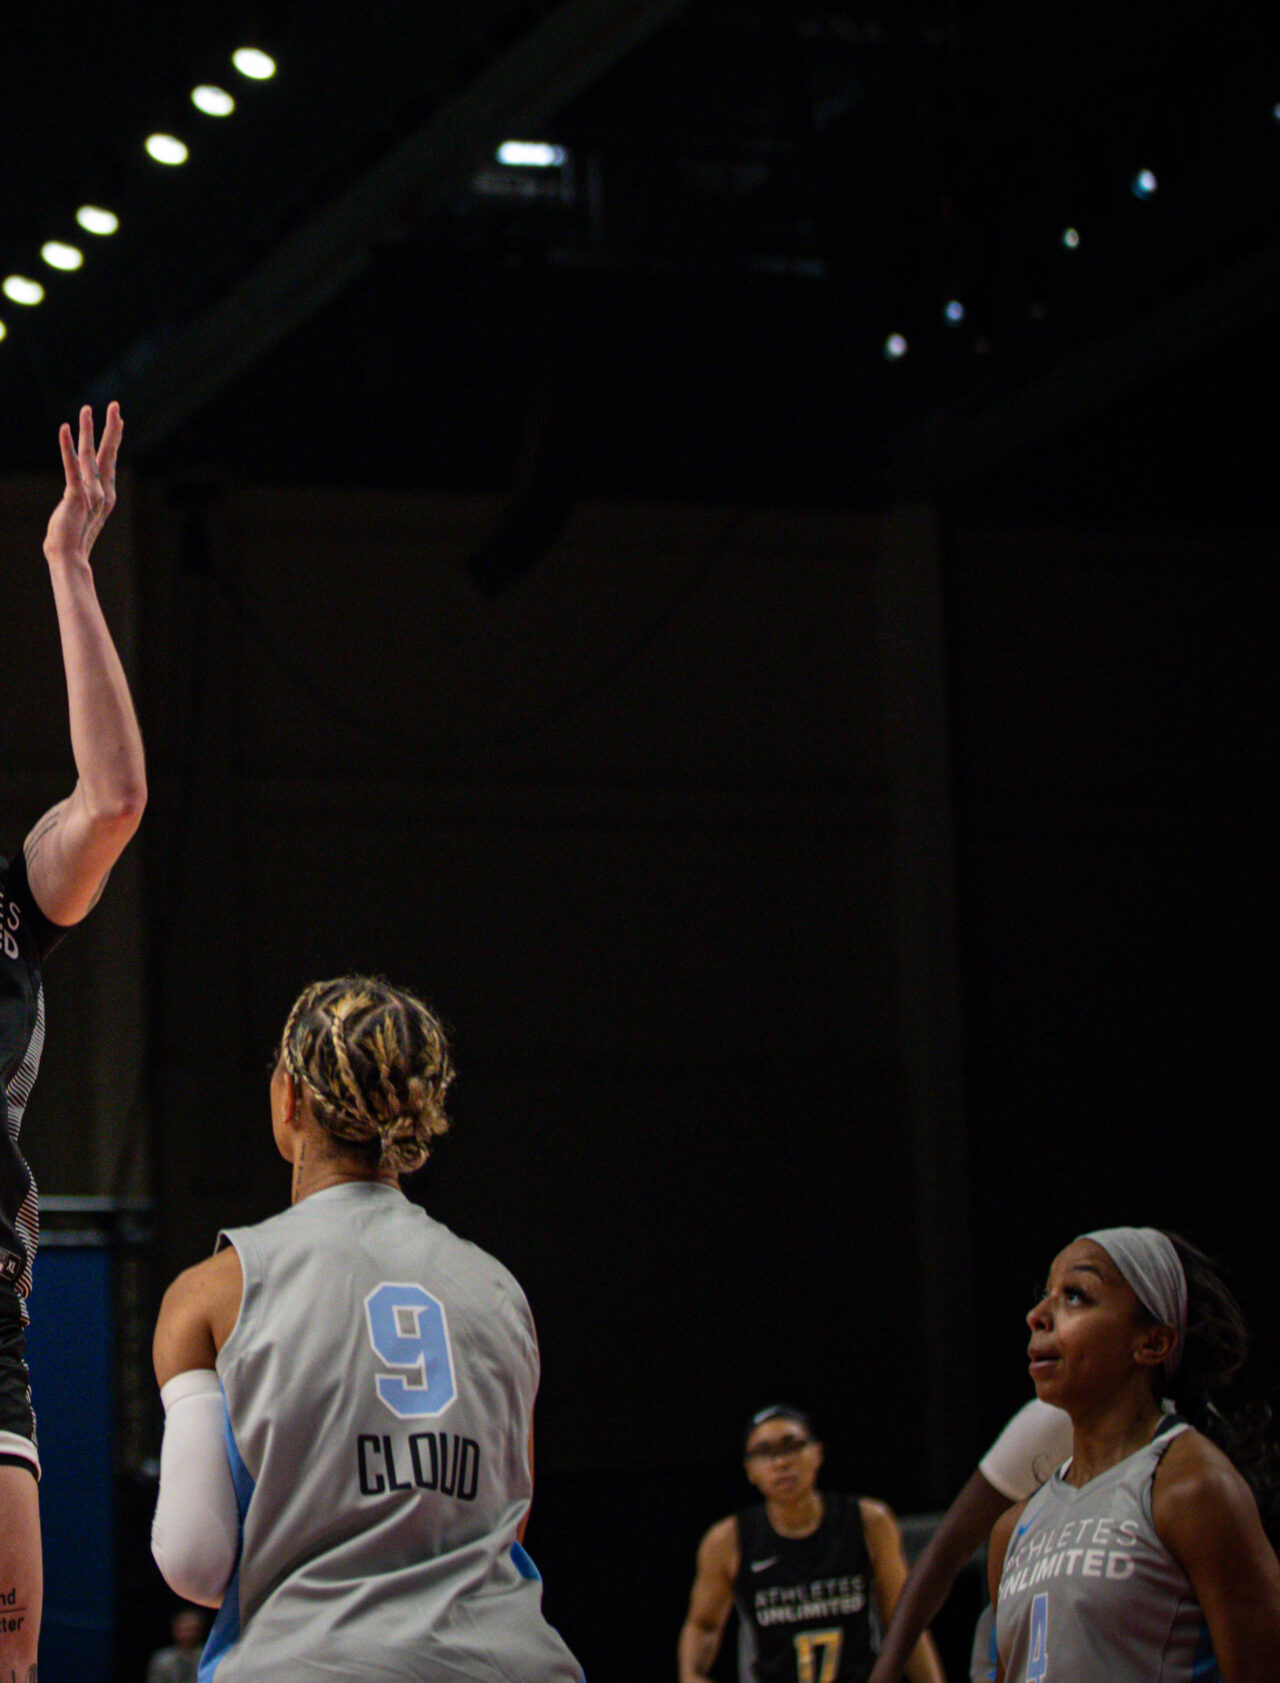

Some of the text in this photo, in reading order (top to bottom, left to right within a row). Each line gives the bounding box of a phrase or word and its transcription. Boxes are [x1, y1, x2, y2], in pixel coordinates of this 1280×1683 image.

[364, 1281, 458, 1420] 9
[357, 1432, 480, 1502] CLOUD
[1005, 1517, 1140, 1573] ATHLETES
[754, 1573, 865, 1608] ATHLETES
[754, 1593, 867, 1628] UNLIMITED
[792, 1625, 845, 1683] 17
[1024, 1591, 1049, 1683] 4
